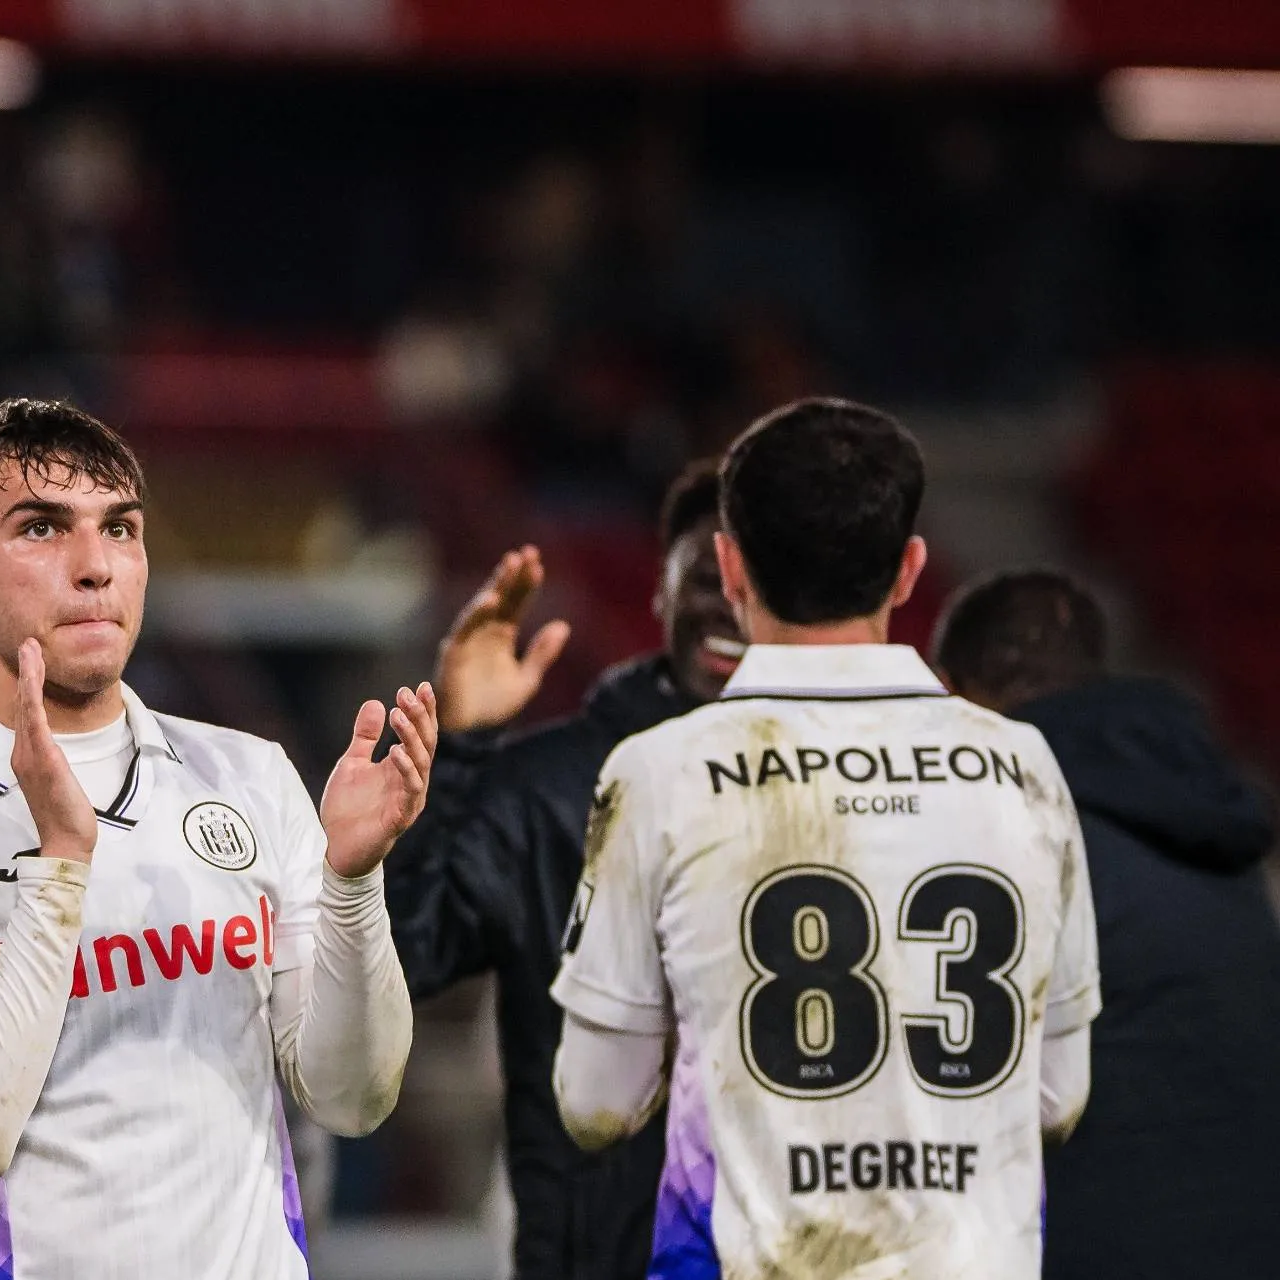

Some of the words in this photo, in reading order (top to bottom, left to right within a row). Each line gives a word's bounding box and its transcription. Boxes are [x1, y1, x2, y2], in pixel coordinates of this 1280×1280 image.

[704, 744, 1026, 796] NAPOLEON
[834, 794, 921, 816] SCORE
[739, 862, 1027, 1100] 83
[788, 1140, 979, 1196] DEGREEF
